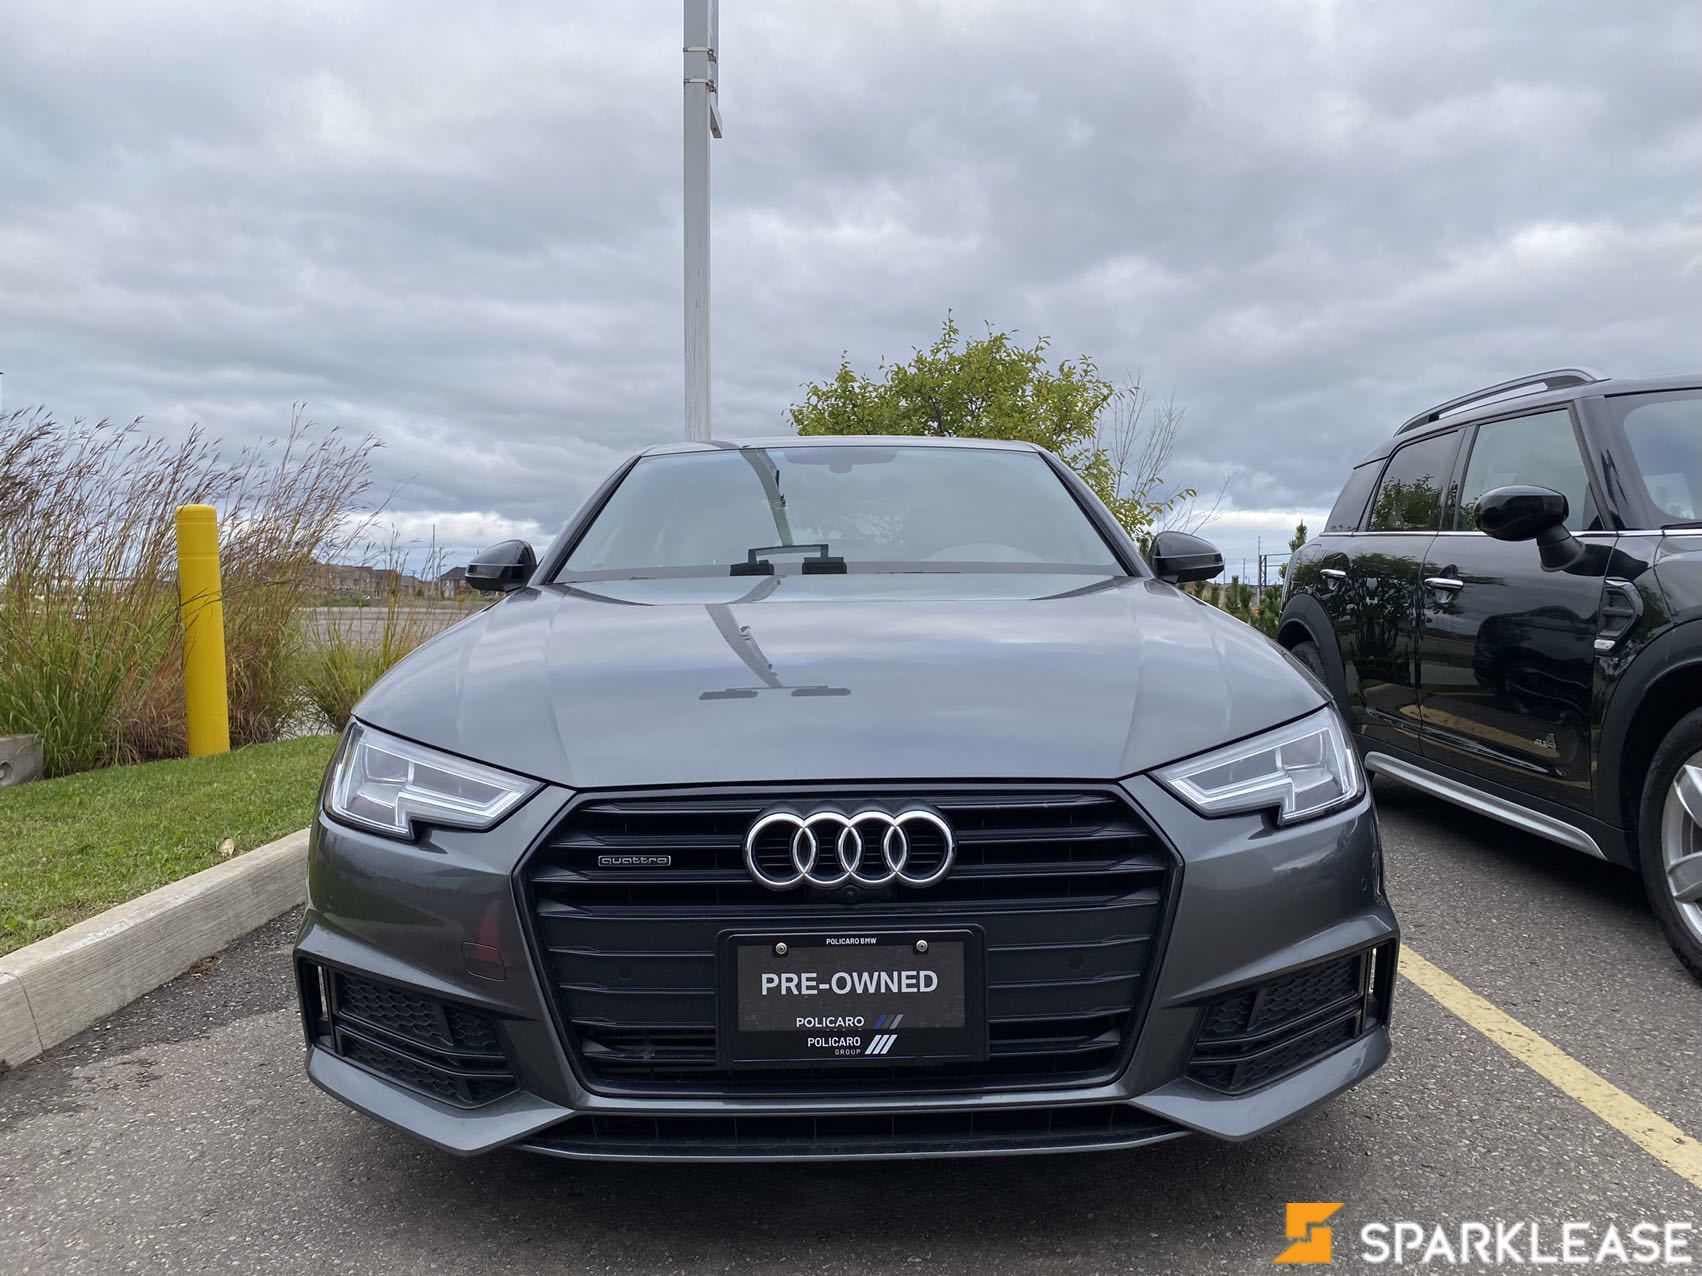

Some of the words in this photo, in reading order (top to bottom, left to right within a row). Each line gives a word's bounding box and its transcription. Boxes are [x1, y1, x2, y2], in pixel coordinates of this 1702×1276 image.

[601, 856, 668, 865] quattro
[826, 937, 860, 945] POLICARO
[860, 937, 877, 945] BMW
[761, 971, 938, 995] PRE-OWNED
[796, 1016, 865, 1028] POLICARO
[807, 1037, 861, 1047] POLICARO
[834, 1048, 862, 1056] GROUP
